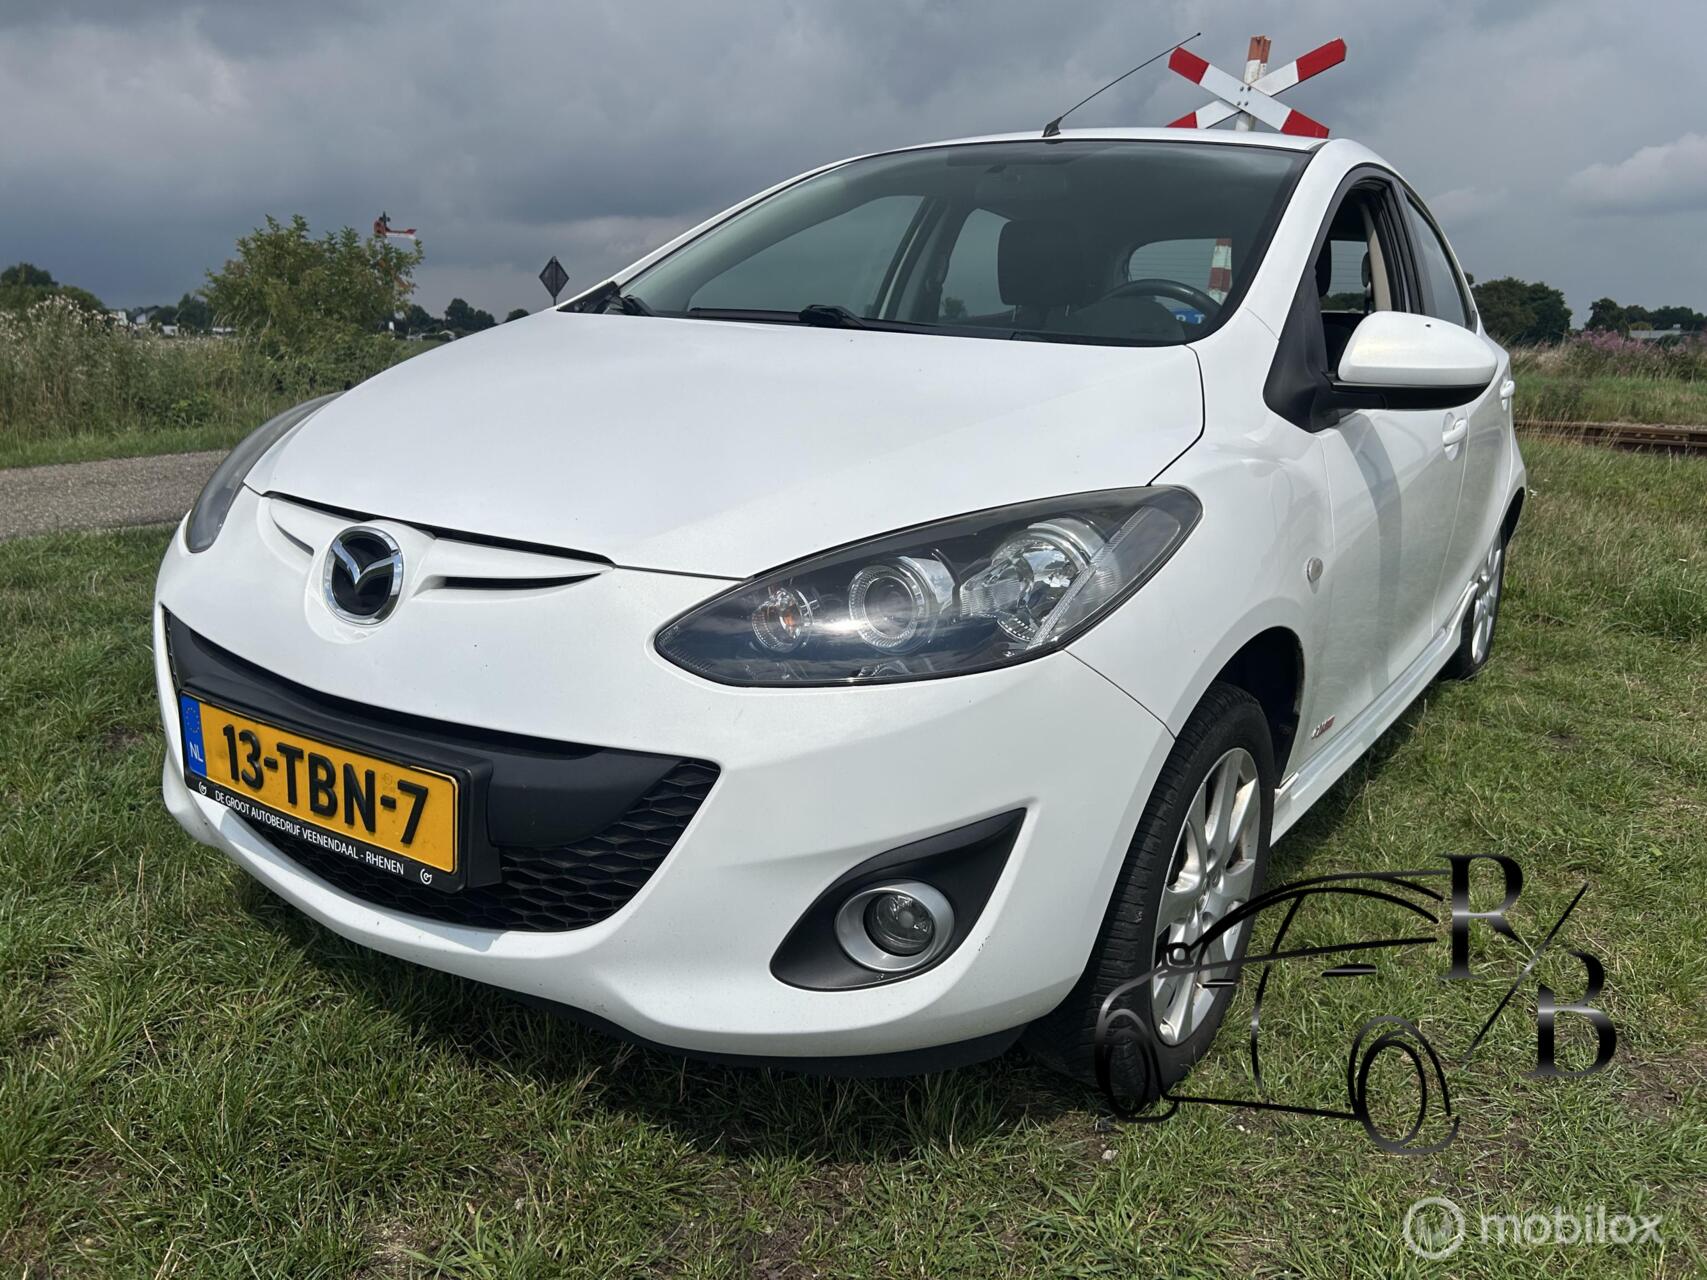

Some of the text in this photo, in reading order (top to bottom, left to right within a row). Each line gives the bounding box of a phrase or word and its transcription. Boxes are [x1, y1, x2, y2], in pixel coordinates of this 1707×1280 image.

[189, 741, 204, 763] NL
[222, 723, 429, 845] 13-TBN-7
[215, 790, 225, 802] DE
[225, 795, 250, 814] GROOT
[251, 808, 301, 837] AUTOBEDRIJF
[301, 827, 359, 860] VEENENDAAL
[366, 851, 404, 875] RHENEN
